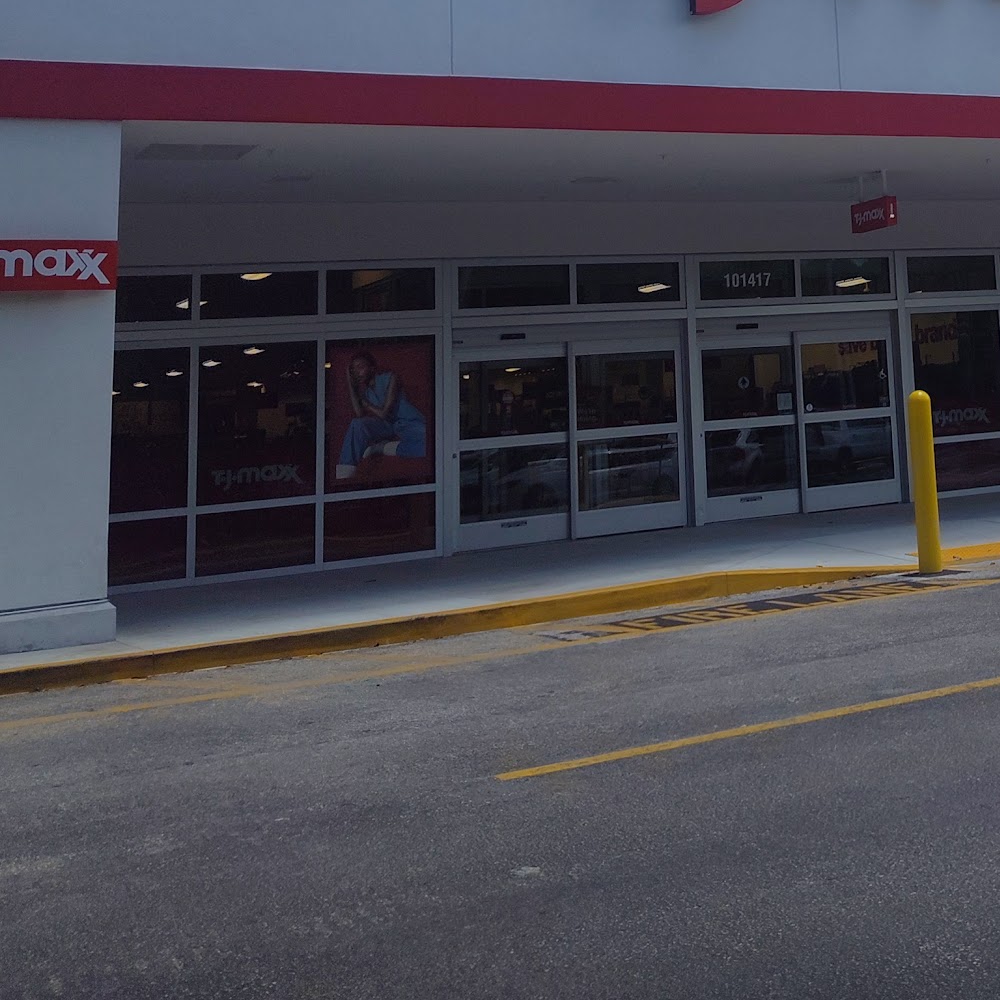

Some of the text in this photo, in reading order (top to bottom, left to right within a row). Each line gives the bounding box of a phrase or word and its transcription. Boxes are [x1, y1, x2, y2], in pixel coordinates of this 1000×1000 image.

[0, 248, 110, 285] maxx
[723, 272, 771, 288] 101417
[617, 581, 939, 631] FIRE LANE
